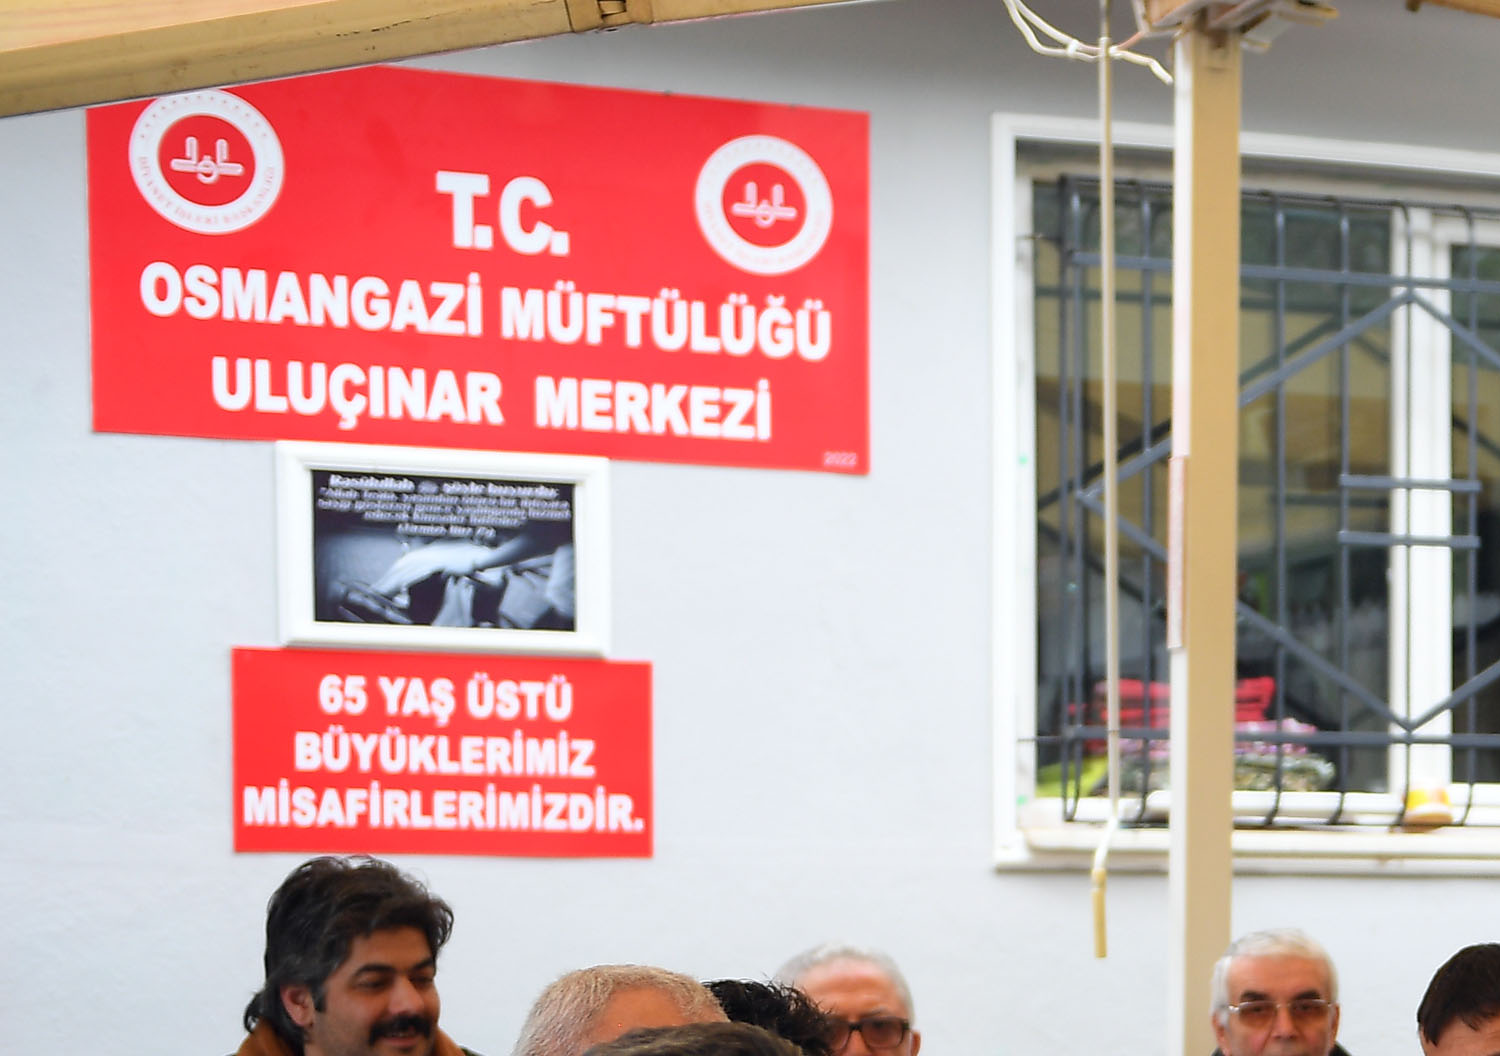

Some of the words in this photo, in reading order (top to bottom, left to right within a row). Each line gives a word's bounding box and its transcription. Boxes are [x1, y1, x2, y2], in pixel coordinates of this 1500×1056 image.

[437, 171, 570, 256] T.C.
[140, 262, 483, 337] OSMANGAZİ
[501, 281, 832, 362] MÜFTÜLÜĞÜ
[212, 357, 505, 430] ULUÇINAR
[535, 376, 772, 441] MERKEZİ
[319, 675, 368, 715] 65
[379, 677, 456, 727] YAŞ
[467, 673, 573, 721] ÜSTÜ
[294, 725, 596, 779] BÜYÜKLERİMİZ
[243, 779, 645, 832] MİSAFİRLERİMİZDİR.
